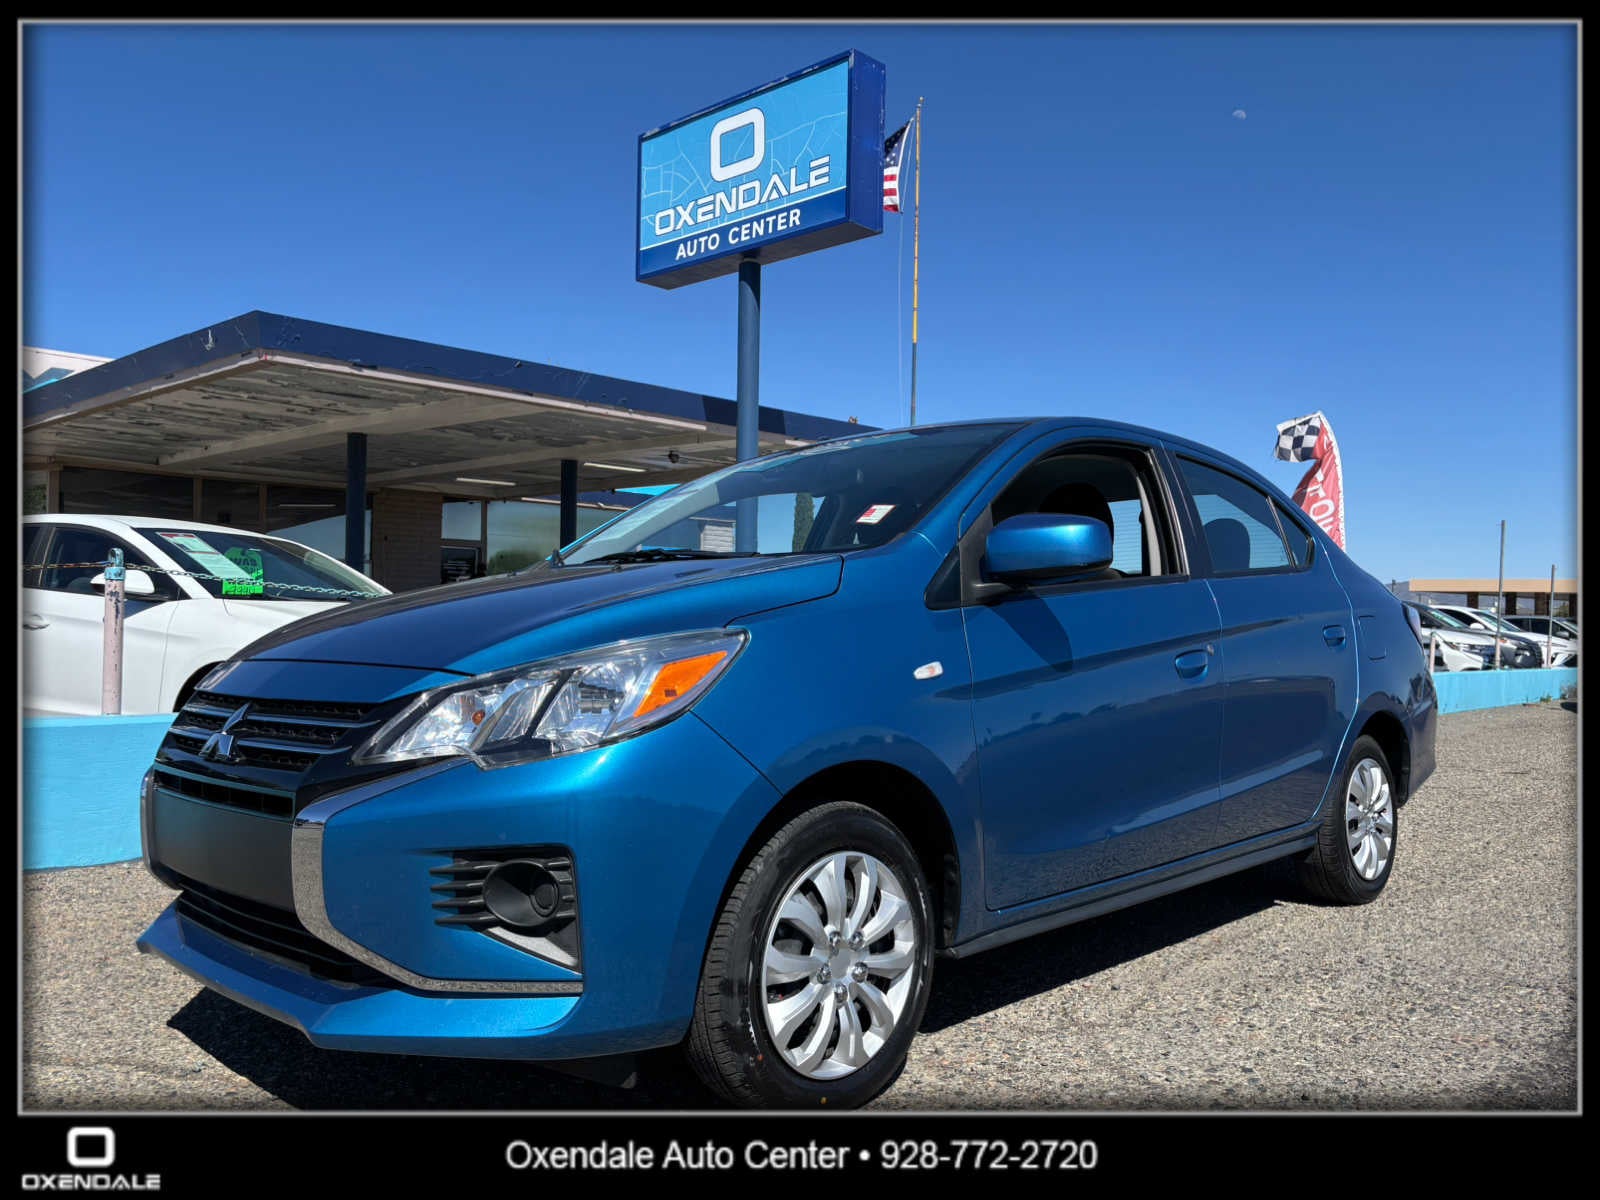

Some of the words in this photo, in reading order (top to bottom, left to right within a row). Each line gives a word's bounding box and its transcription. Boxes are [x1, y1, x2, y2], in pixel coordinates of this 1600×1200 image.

[710, 107, 766, 182] O
[654, 155, 831, 236] OXENDALE
[675, 232, 721, 260] AUTO
[728, 208, 802, 245] CENTER
